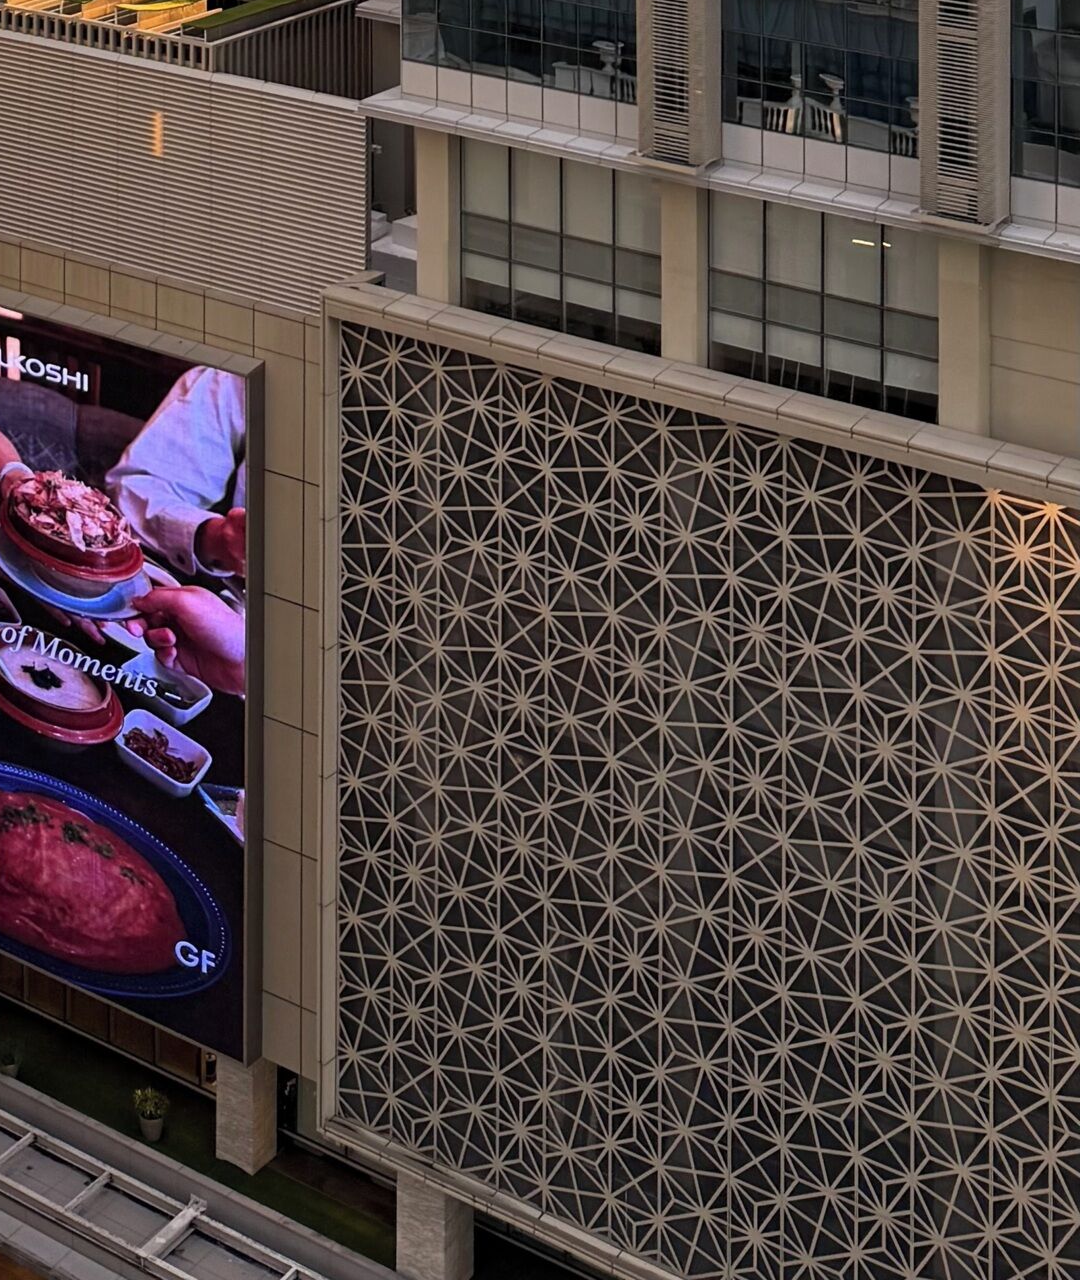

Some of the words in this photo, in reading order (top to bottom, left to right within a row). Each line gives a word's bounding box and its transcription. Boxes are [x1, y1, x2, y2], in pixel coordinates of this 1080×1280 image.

[1, 625, 33, 652] of
[30, 631, 158, 698] Moments
[175, 941, 216, 974] GF
